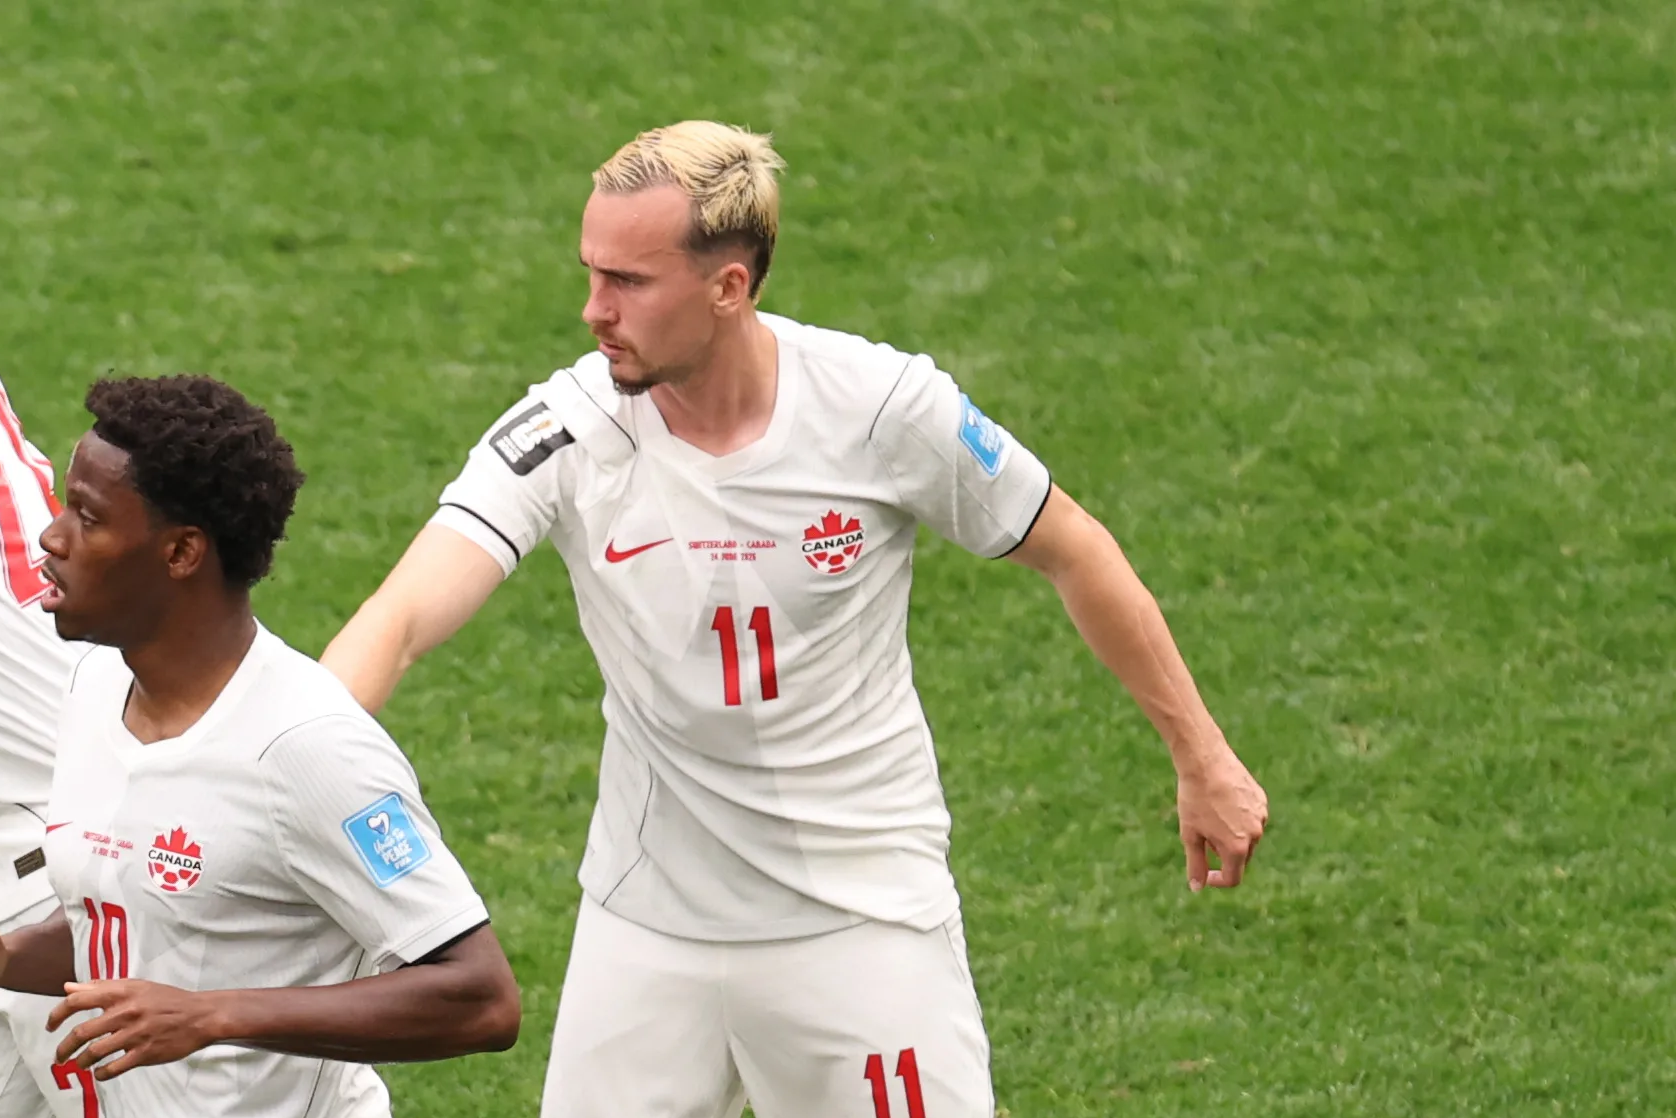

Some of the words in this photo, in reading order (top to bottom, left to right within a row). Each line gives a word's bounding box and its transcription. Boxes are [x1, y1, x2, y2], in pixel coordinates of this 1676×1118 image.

[802, 531, 863, 553] CANADA
[711, 606, 779, 706] 11
[148, 849, 202, 871] CANADA
[83, 896, 128, 980] 10
